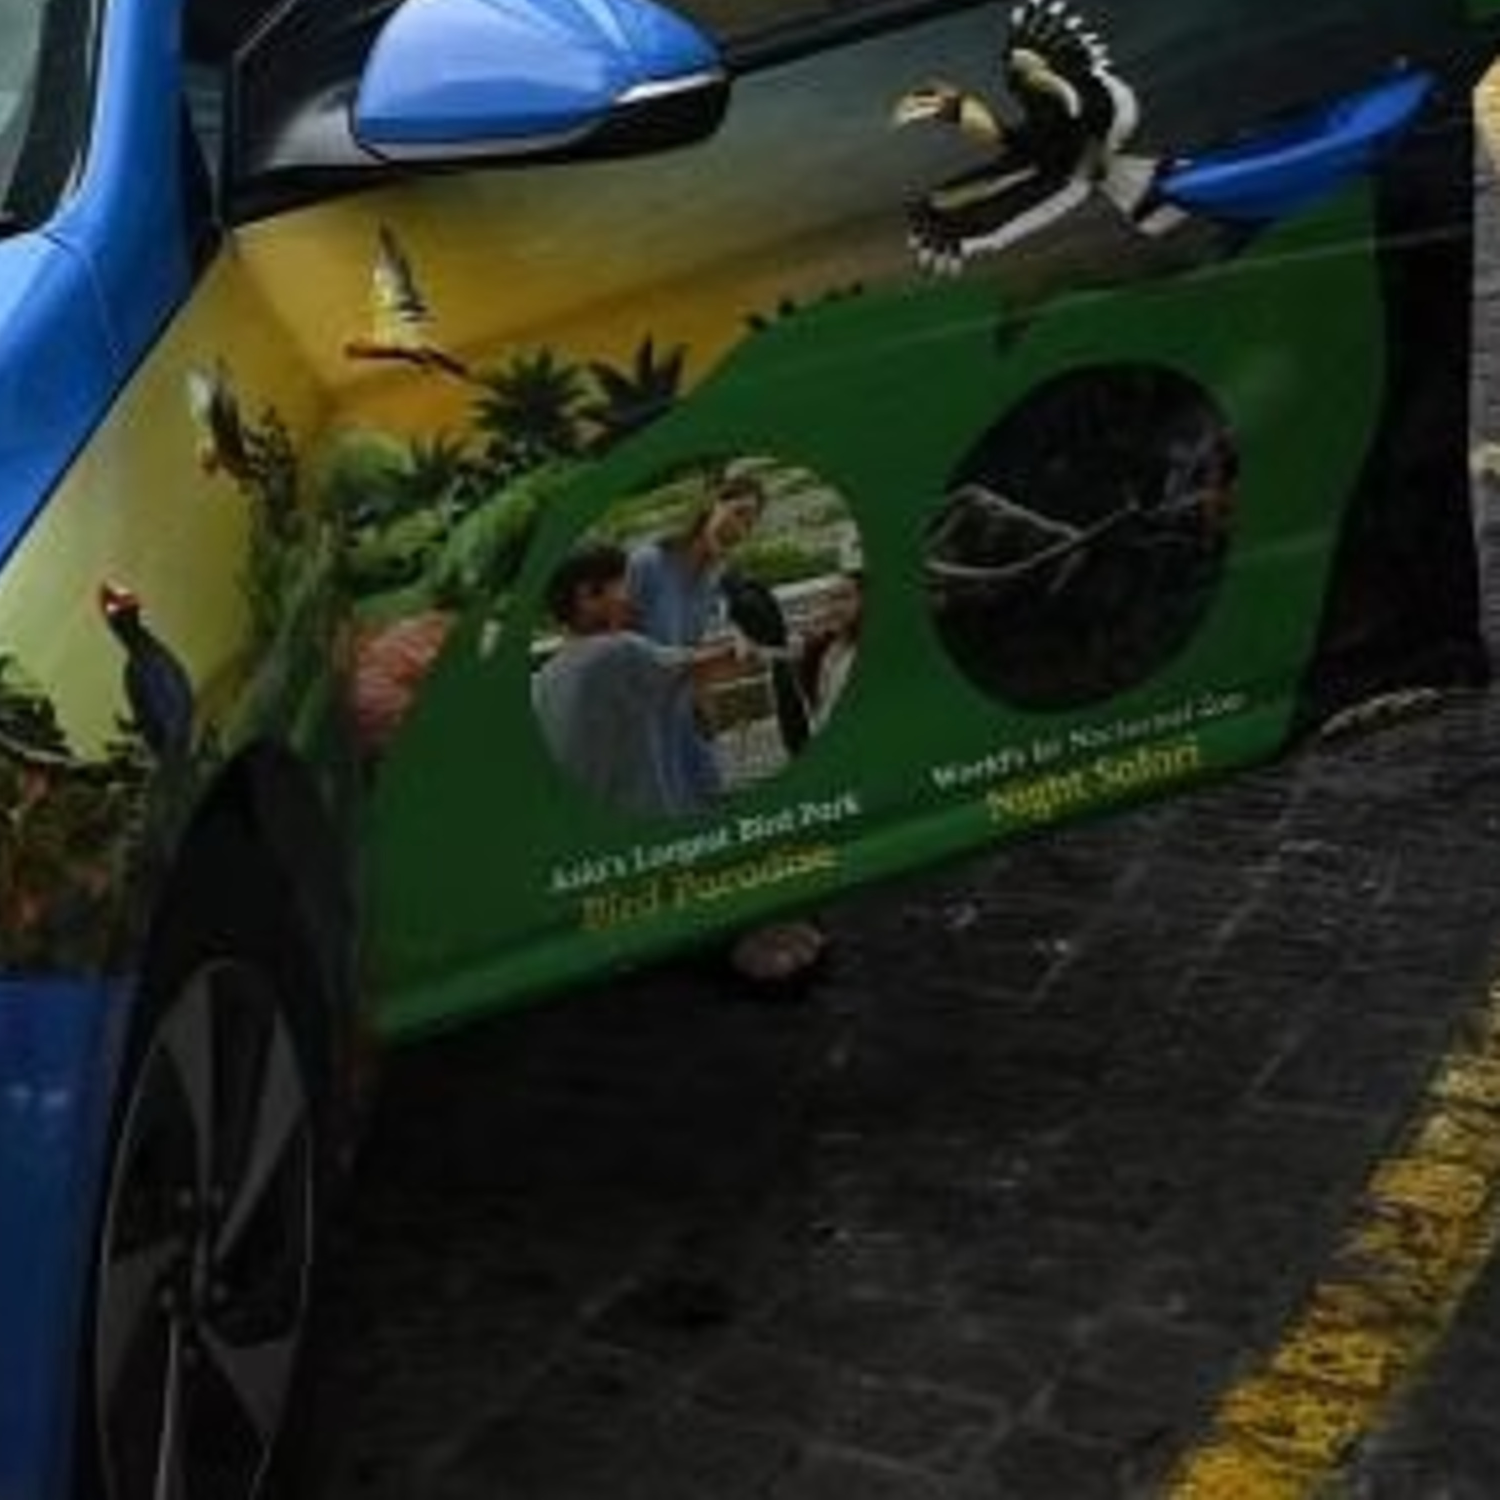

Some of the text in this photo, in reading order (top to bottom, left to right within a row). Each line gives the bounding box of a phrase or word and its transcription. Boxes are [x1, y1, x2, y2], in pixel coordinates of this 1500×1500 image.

[986, 734, 1200, 825] Night Safari
[739, 808, 795, 842] Bird
[799, 790, 861, 826] Park
